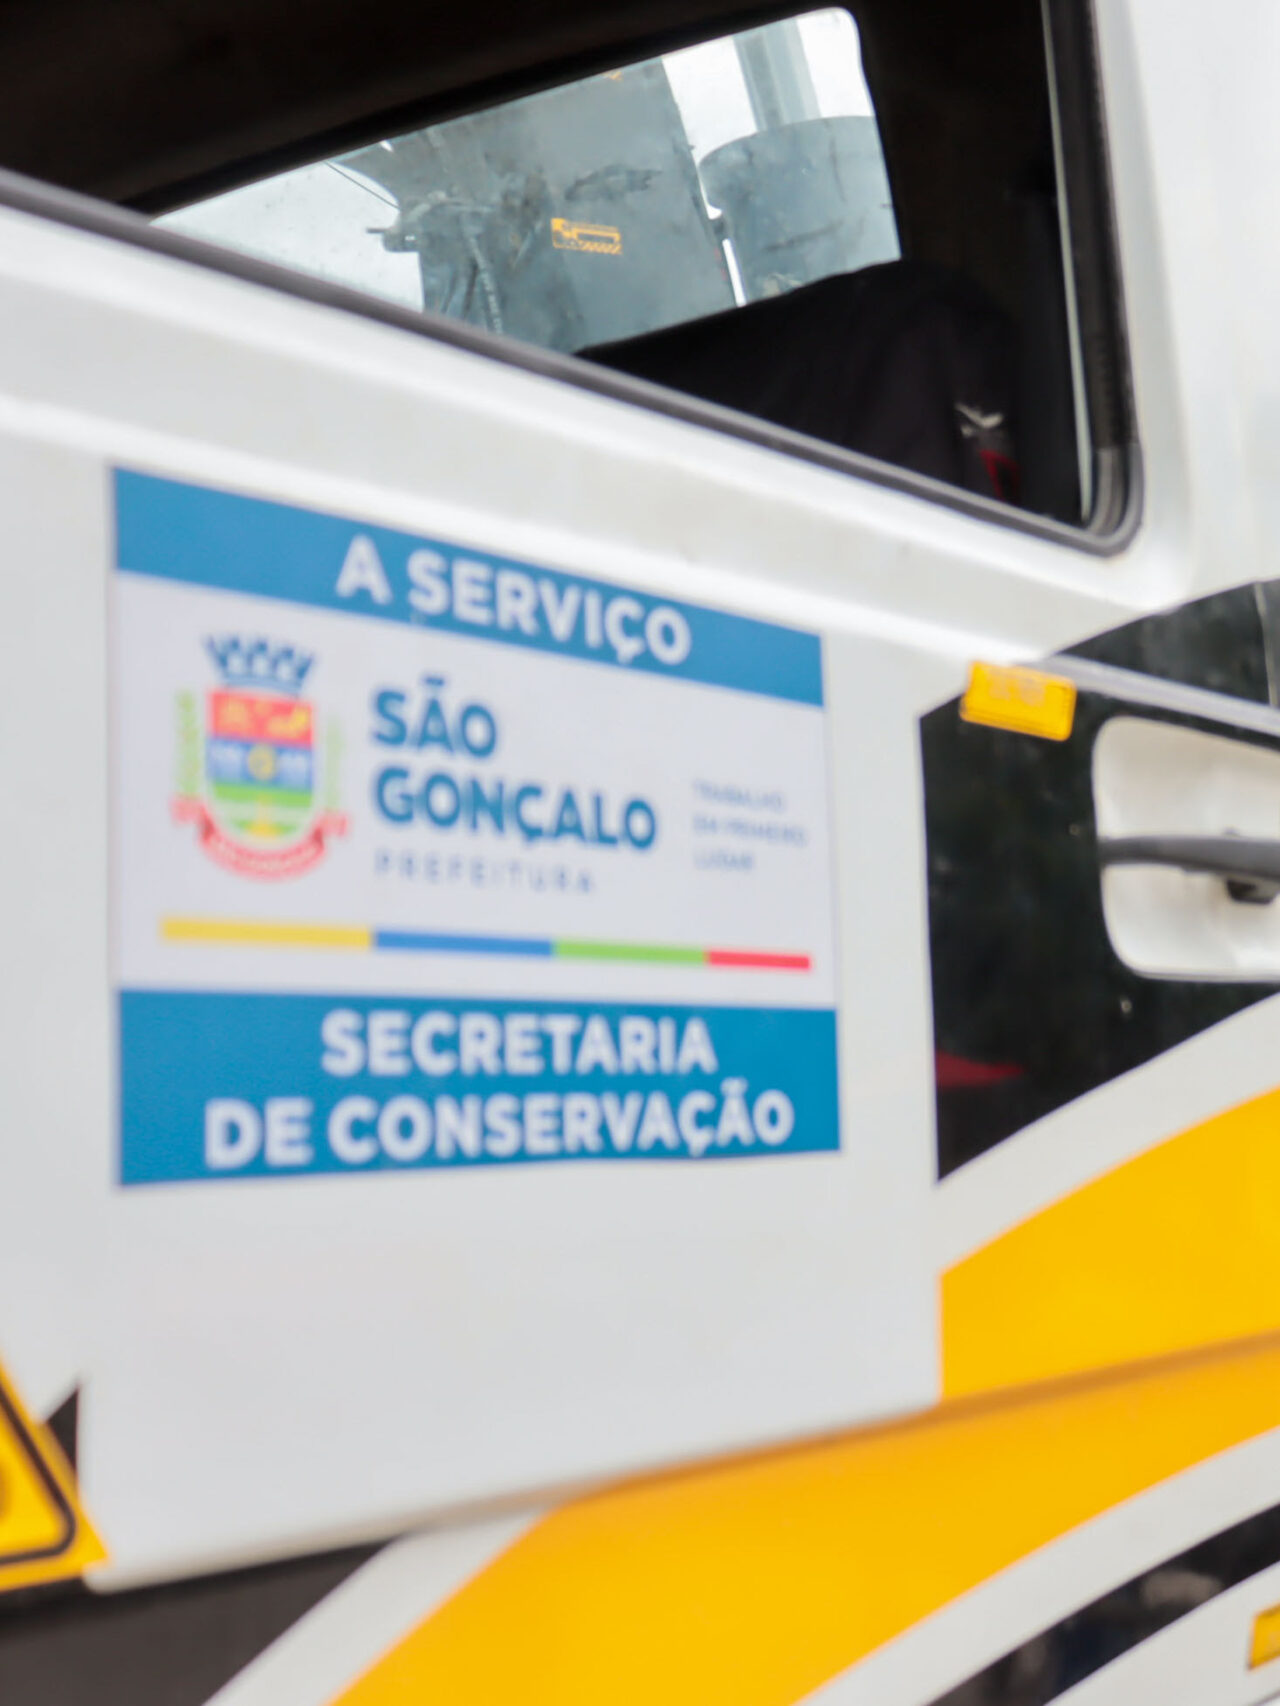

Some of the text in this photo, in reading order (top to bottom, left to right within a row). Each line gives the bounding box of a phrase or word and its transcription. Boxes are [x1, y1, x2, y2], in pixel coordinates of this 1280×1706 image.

[335, 535, 692, 666] A SERVIÇO
[372, 673, 498, 758] SÃO
[375, 768, 657, 852] GONÇALO
[374, 849, 597, 895] PREFEITURA
[320, 1009, 719, 1077] SECRETARIA
[203, 1077, 796, 1170] DE CONSERVAÇÃO
